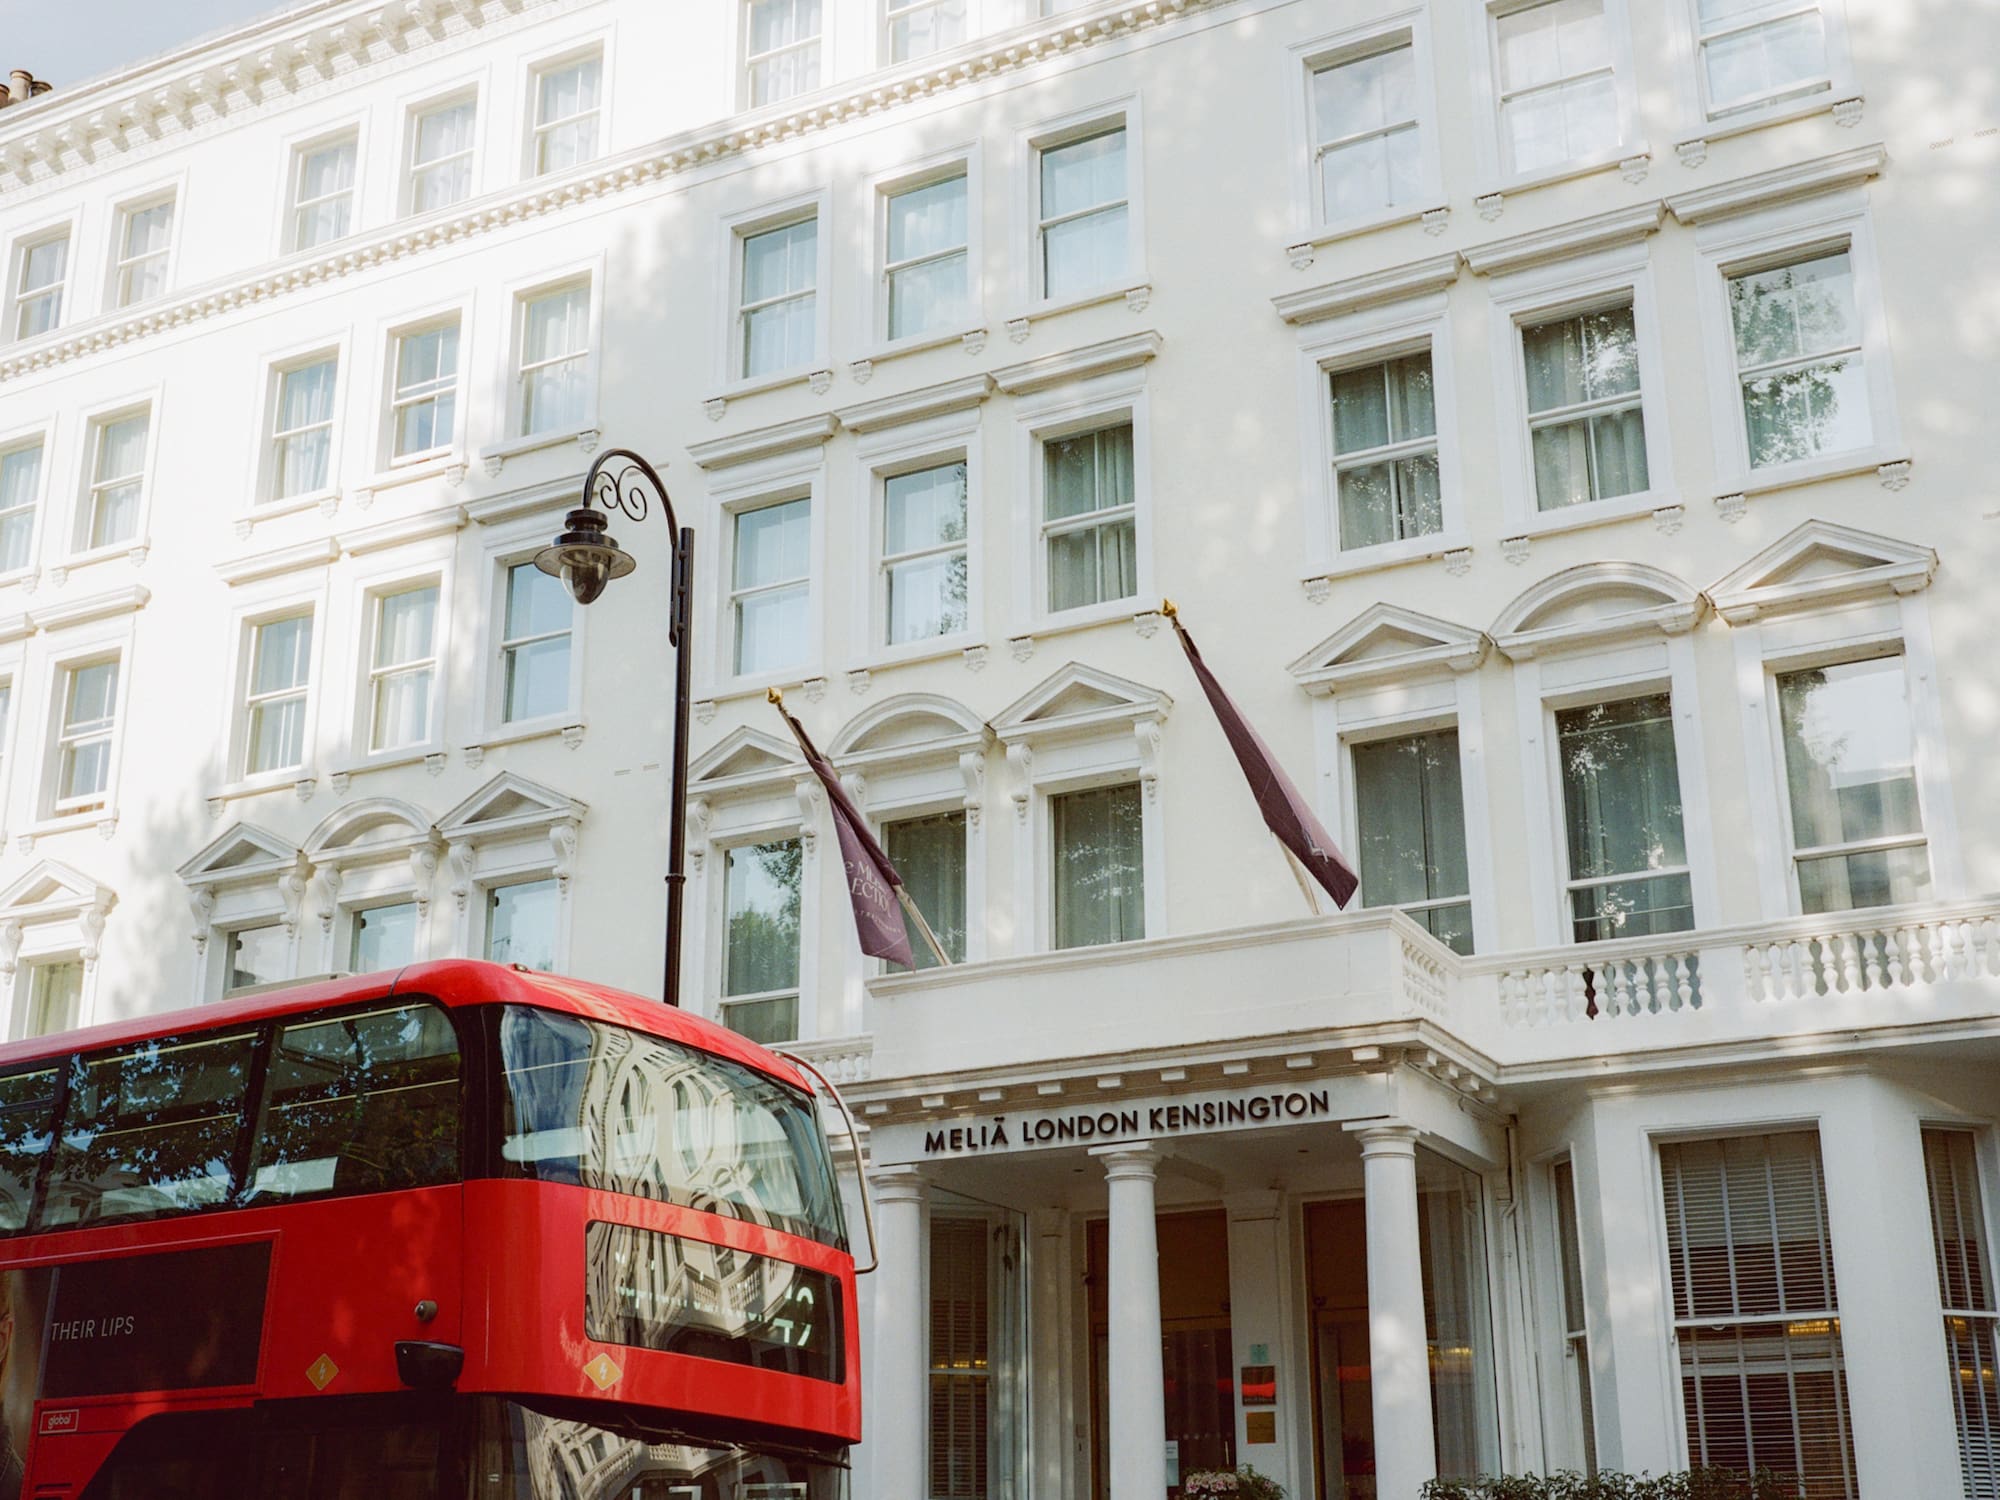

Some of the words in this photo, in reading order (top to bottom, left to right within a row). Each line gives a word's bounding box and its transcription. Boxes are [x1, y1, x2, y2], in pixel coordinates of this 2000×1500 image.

[1022, 1110, 1139, 1144] LONDON
[1149, 1090, 1330, 1131] KENSINGTON
[51, 1319, 96, 1341] THEIR
[101, 1315, 136, 1337] LIPS
[47, 1413, 72, 1431] global
